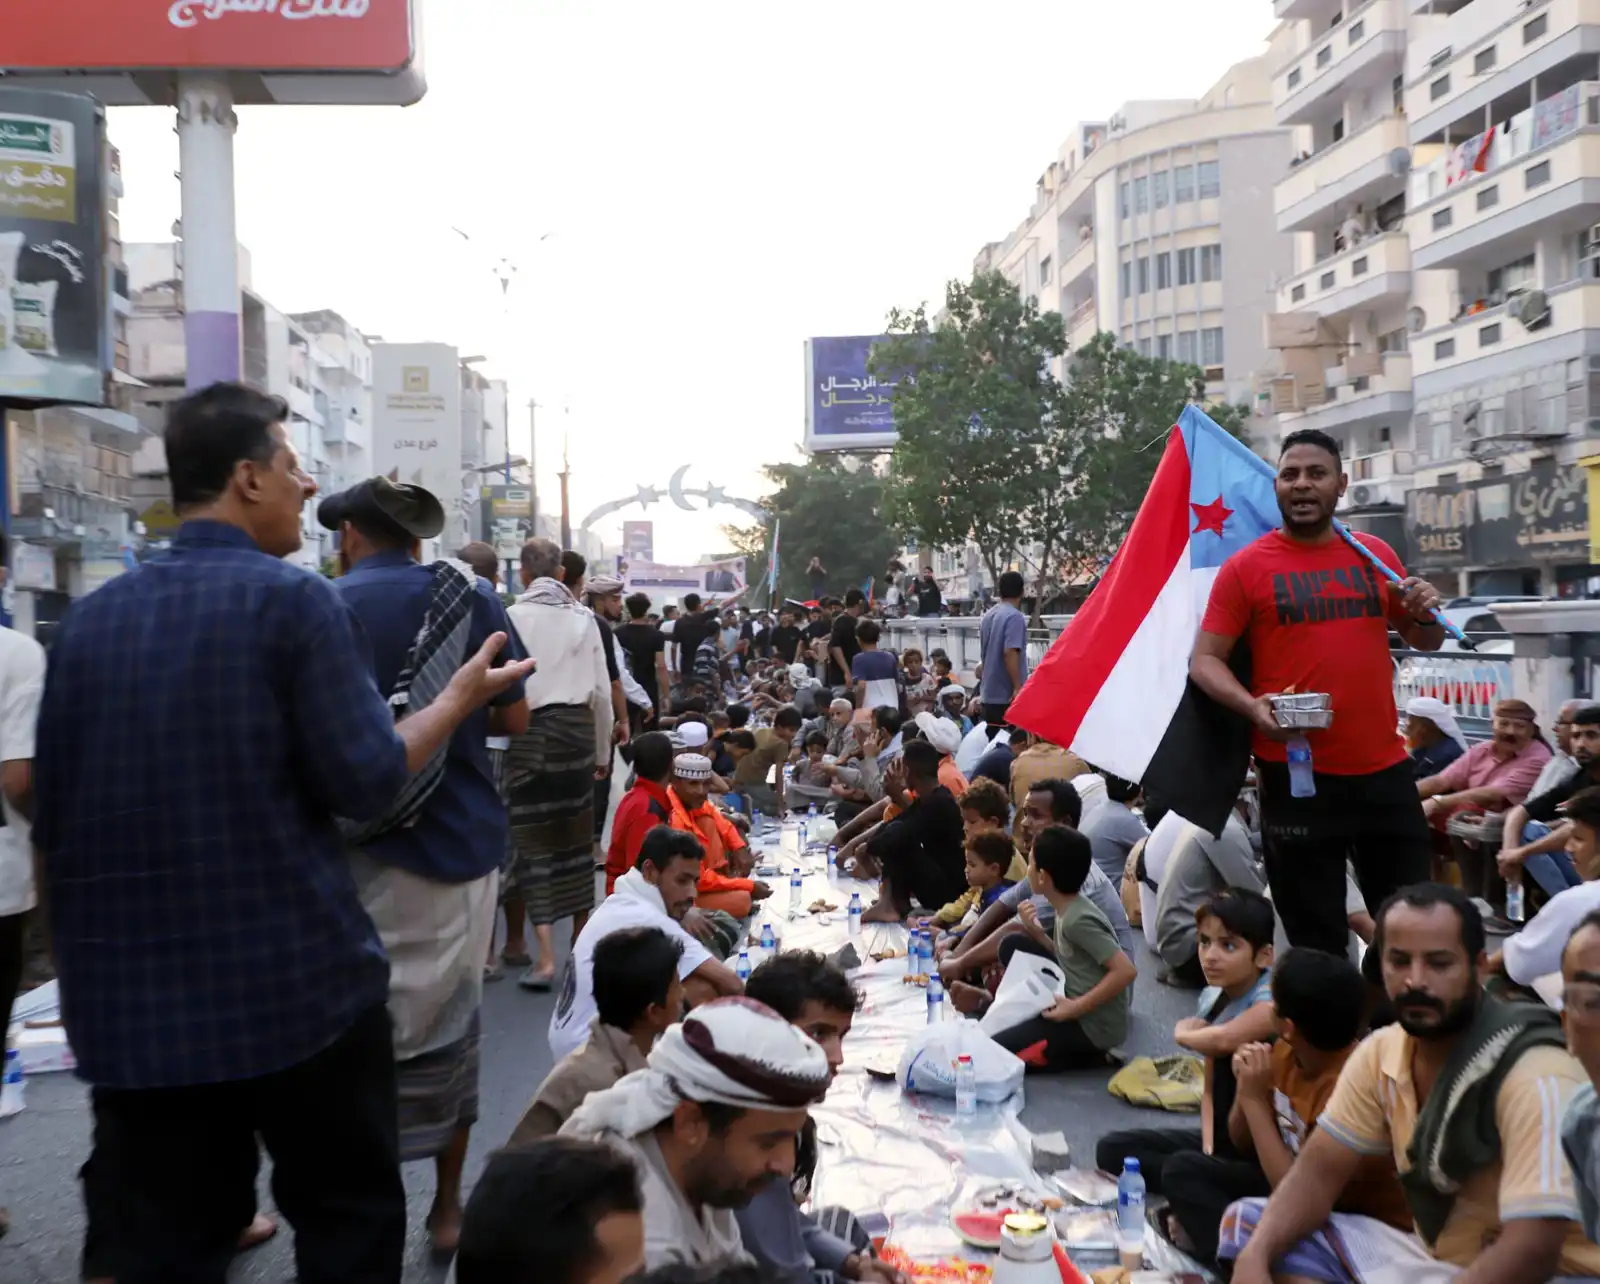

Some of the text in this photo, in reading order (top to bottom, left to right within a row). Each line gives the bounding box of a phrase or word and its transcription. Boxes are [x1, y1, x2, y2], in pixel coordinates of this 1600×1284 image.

[820, 376, 877, 392] الرجال
[393, 439, 438, 450] فرع عدن
[1419, 532, 1463, 552] SALES
